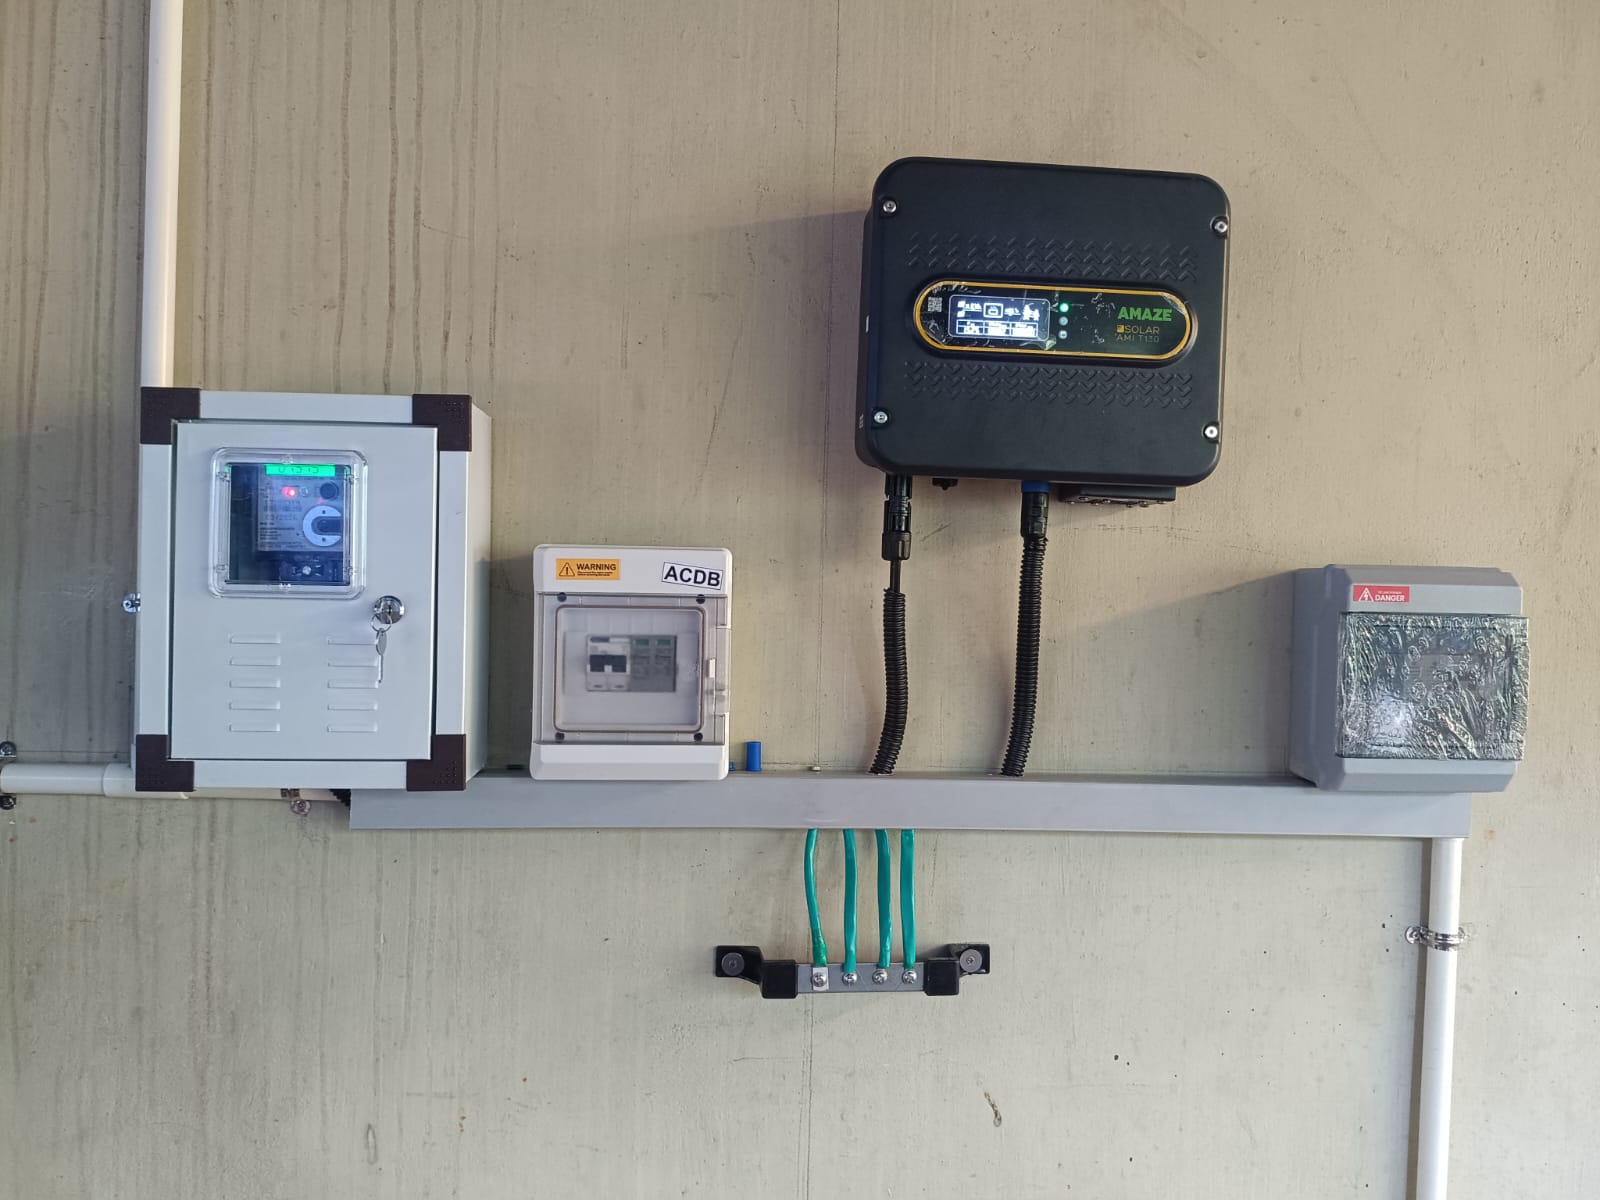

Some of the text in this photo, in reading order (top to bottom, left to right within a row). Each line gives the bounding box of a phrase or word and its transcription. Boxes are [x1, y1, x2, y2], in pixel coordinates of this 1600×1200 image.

[1118, 306, 1172, 321] AMAZE
[1125, 325, 1160, 334] SOLAR
[576, 563, 617, 571] WARNING
[663, 565, 721, 587] ACDB
[1375, 594, 1405, 602] DANGER
